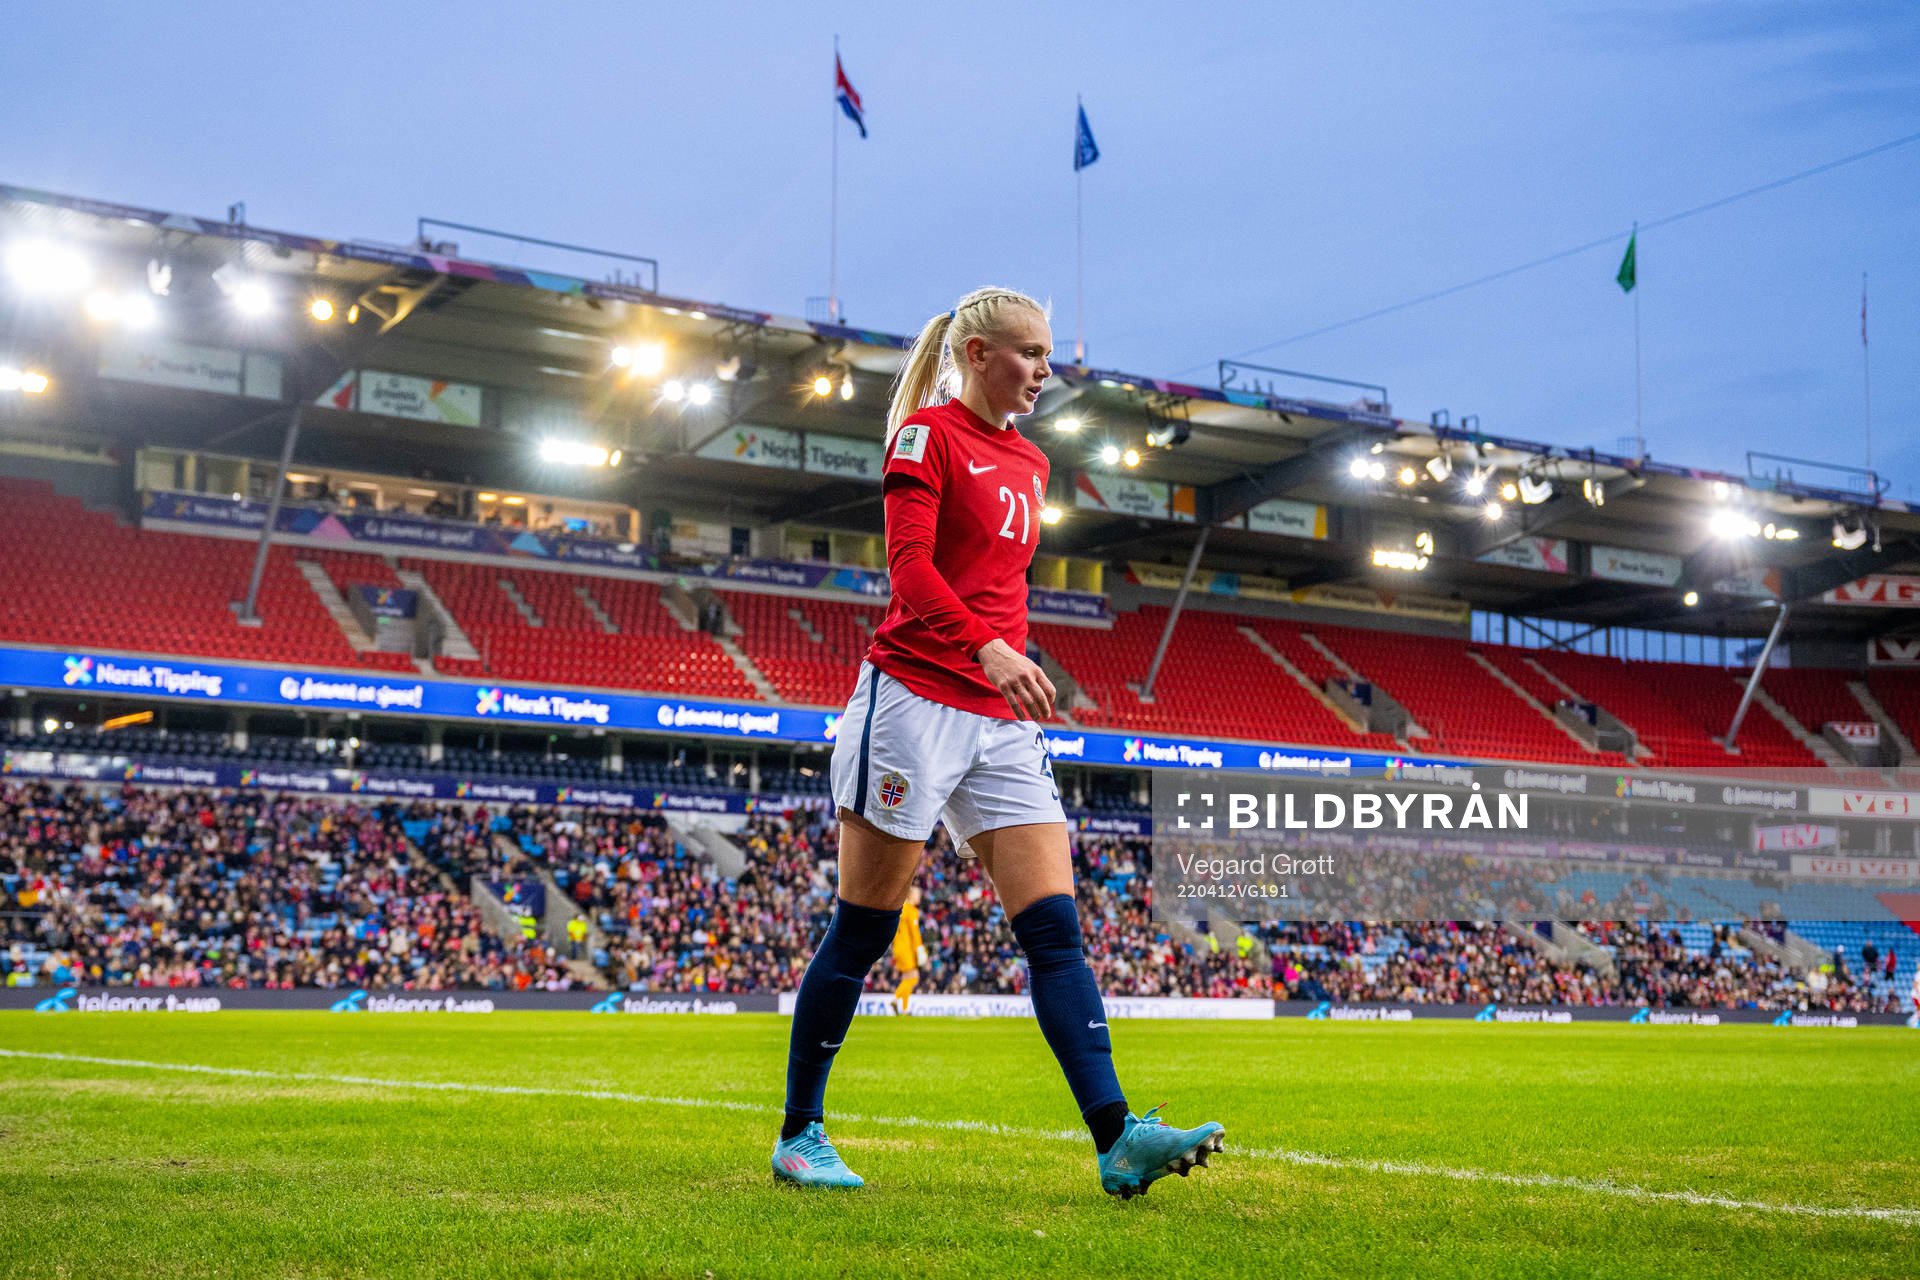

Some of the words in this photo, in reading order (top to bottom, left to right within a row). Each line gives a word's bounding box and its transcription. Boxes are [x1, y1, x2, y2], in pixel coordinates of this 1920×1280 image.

[811, 446, 868, 474] Tipping
[999, 486, 1030, 544] 21
[96, 663, 152, 687] Norsk
[152, 666, 222, 697] Tipping
[503, 693, 551, 716] Norsk
[550, 696, 610, 724] Tipping
[77, 992, 163, 1012] telenor
[367, 993, 442, 1013] telenor
[624, 996, 690, 1014] telenor
